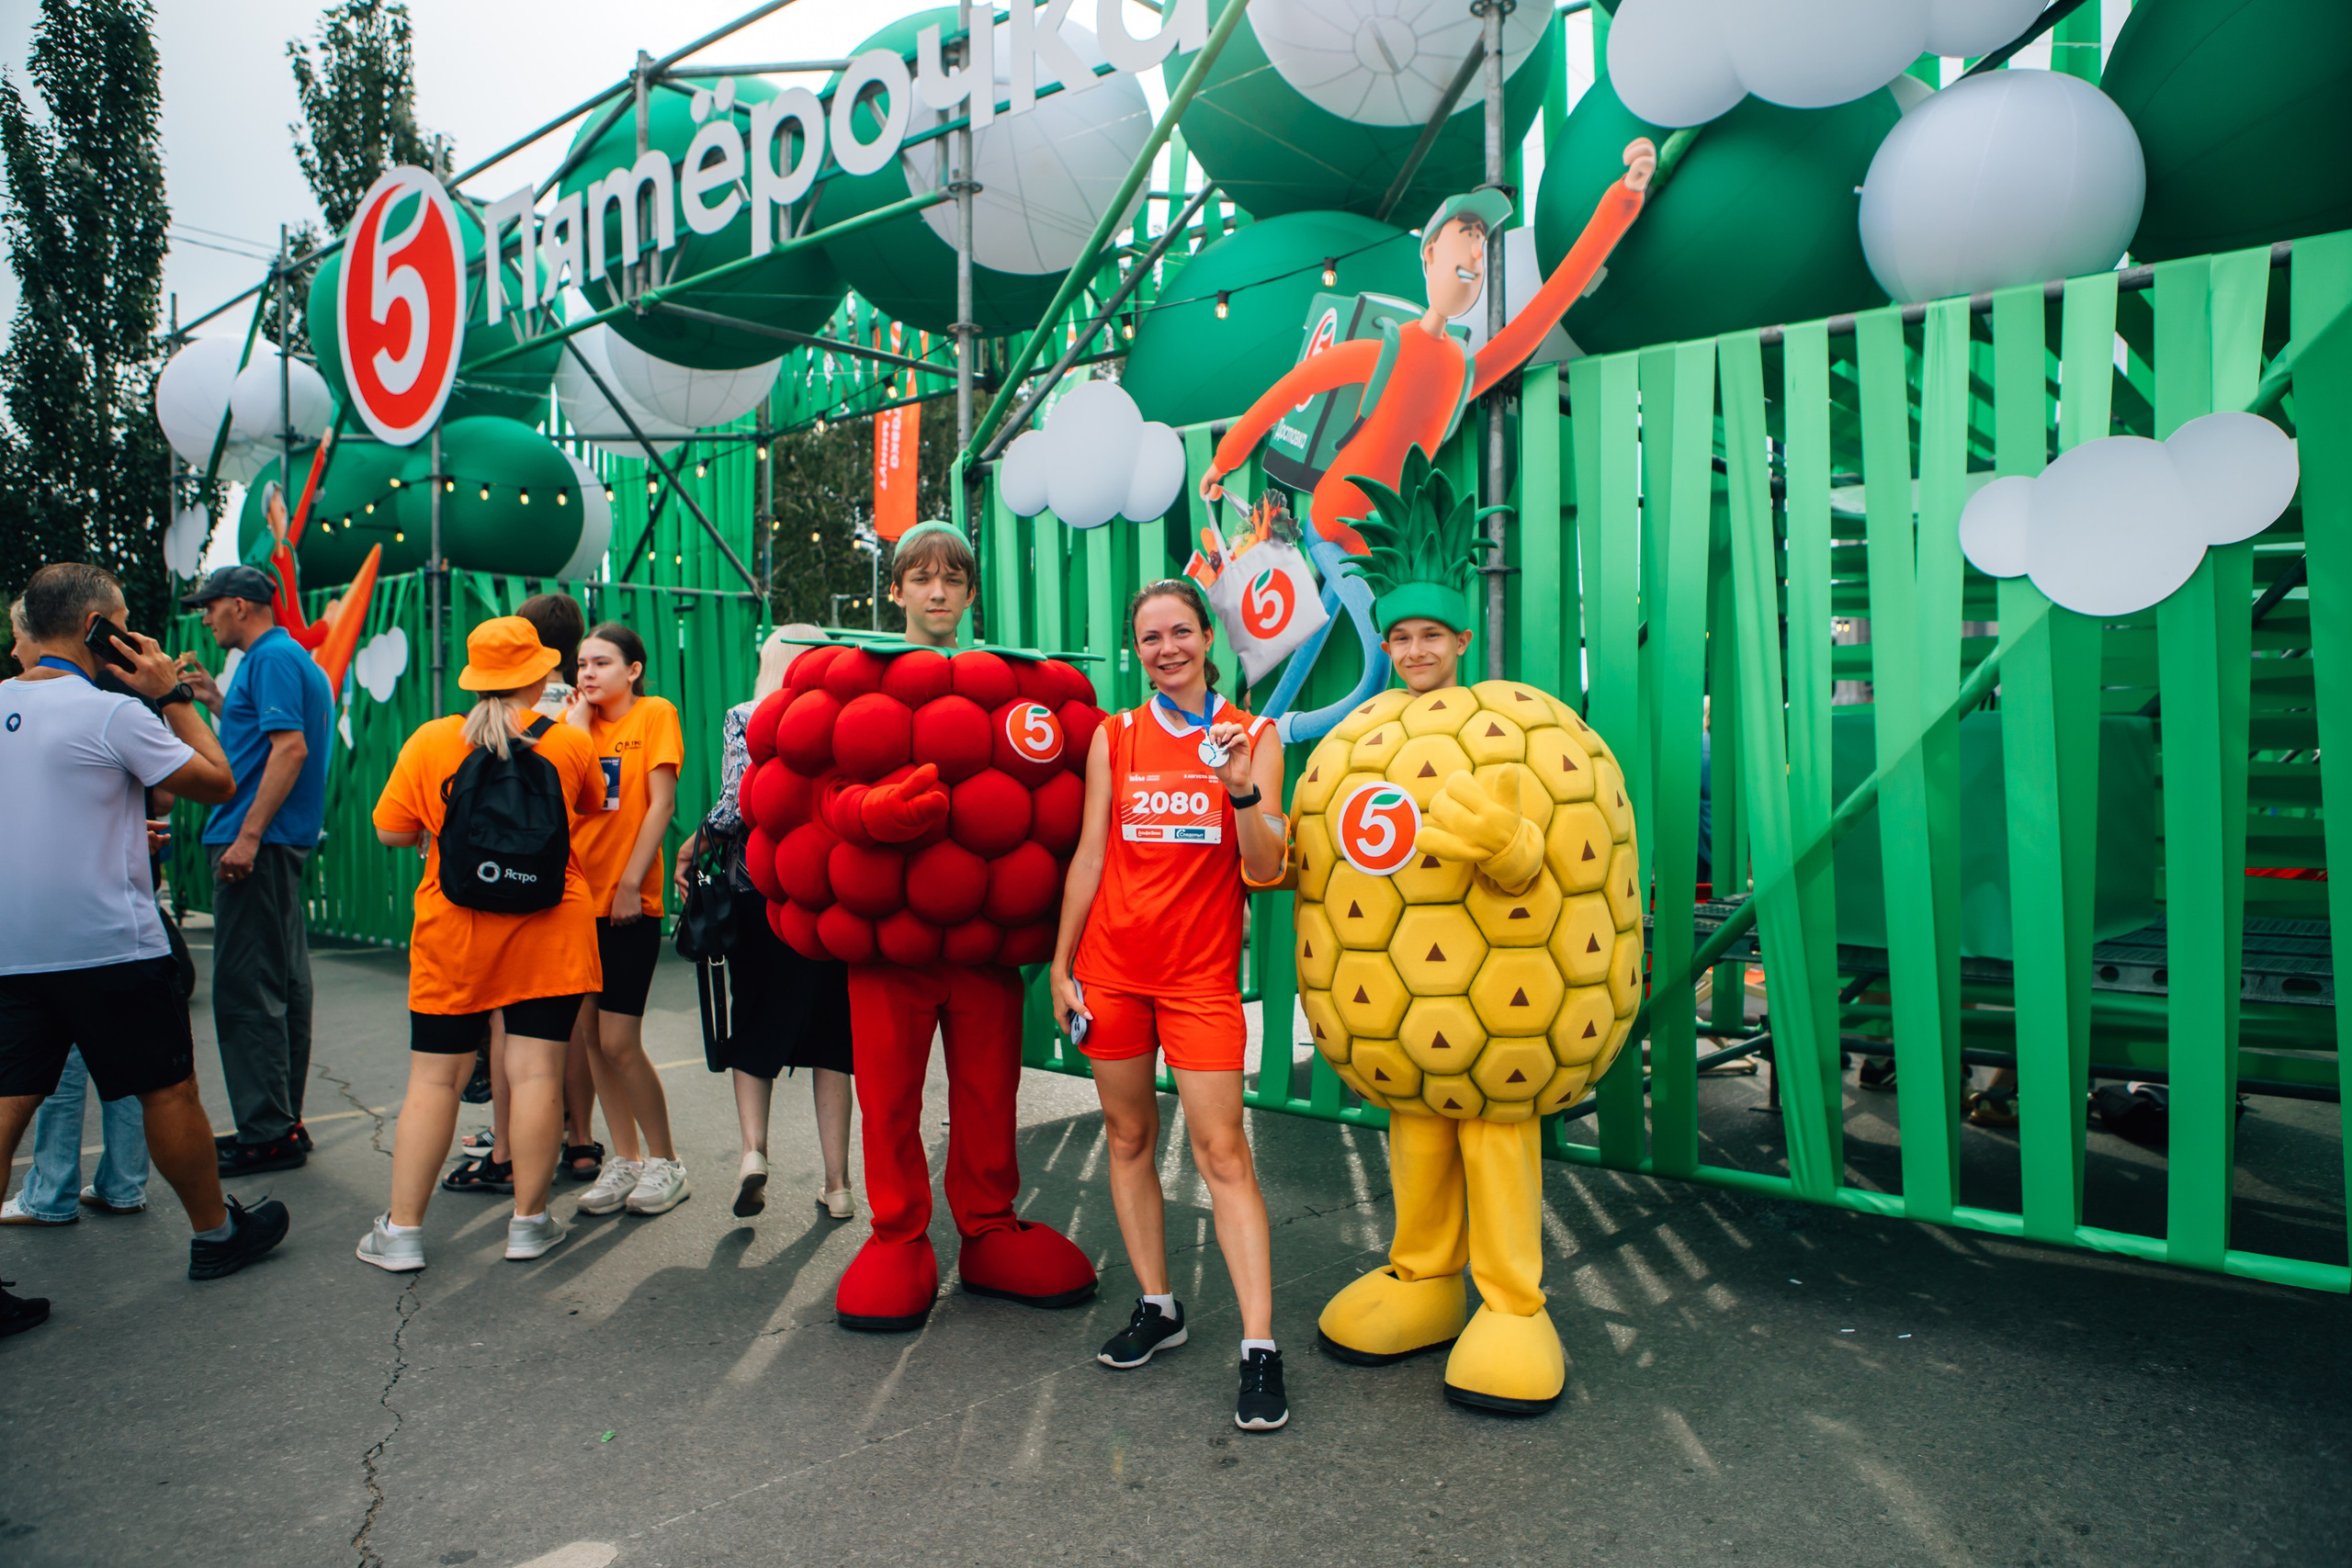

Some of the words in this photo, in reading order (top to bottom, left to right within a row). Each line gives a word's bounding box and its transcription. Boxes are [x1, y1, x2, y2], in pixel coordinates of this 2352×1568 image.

[371, 183, 430, 395] 5
[1273, 417, 1307, 449] Доставка
[1251, 568, 1284, 630] 5
[1024, 705, 1055, 751] 5
[1132, 791, 1210, 816] 2080
[1356, 788, 1406, 858] 5
[504, 867, 537, 884] Ястро
